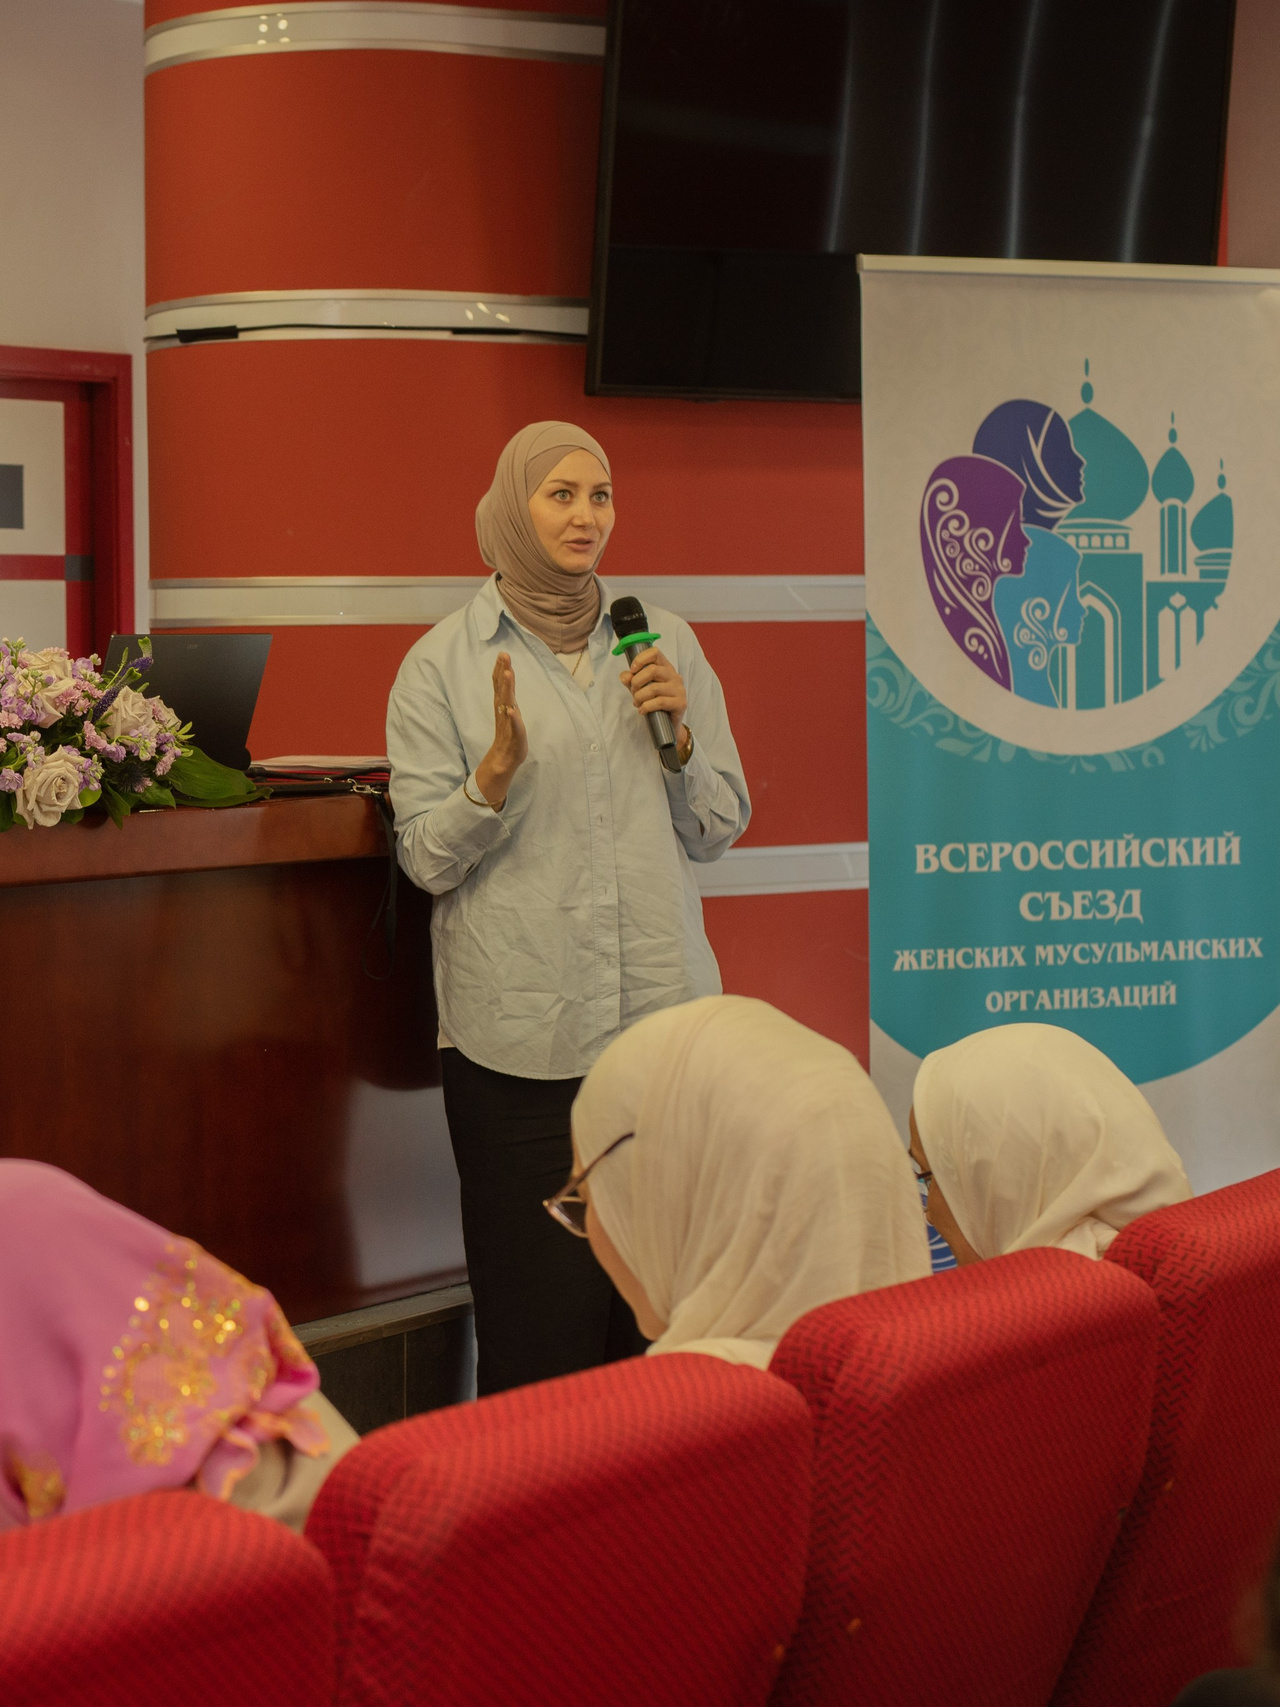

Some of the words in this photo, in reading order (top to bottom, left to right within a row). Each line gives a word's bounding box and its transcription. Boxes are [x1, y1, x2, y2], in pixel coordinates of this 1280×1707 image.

[915, 831, 1241, 874] ВСЕРОССИЙСКИЙ
[1019, 889, 1144, 925] СЪЕЗД
[892, 945, 1027, 972] ЖЕНСКИХ
[1035, 937, 1263, 966] МУСУЛЬМАНСКИХ
[985, 980, 1177, 1012] ОРГАНИЗАЦИЙ
